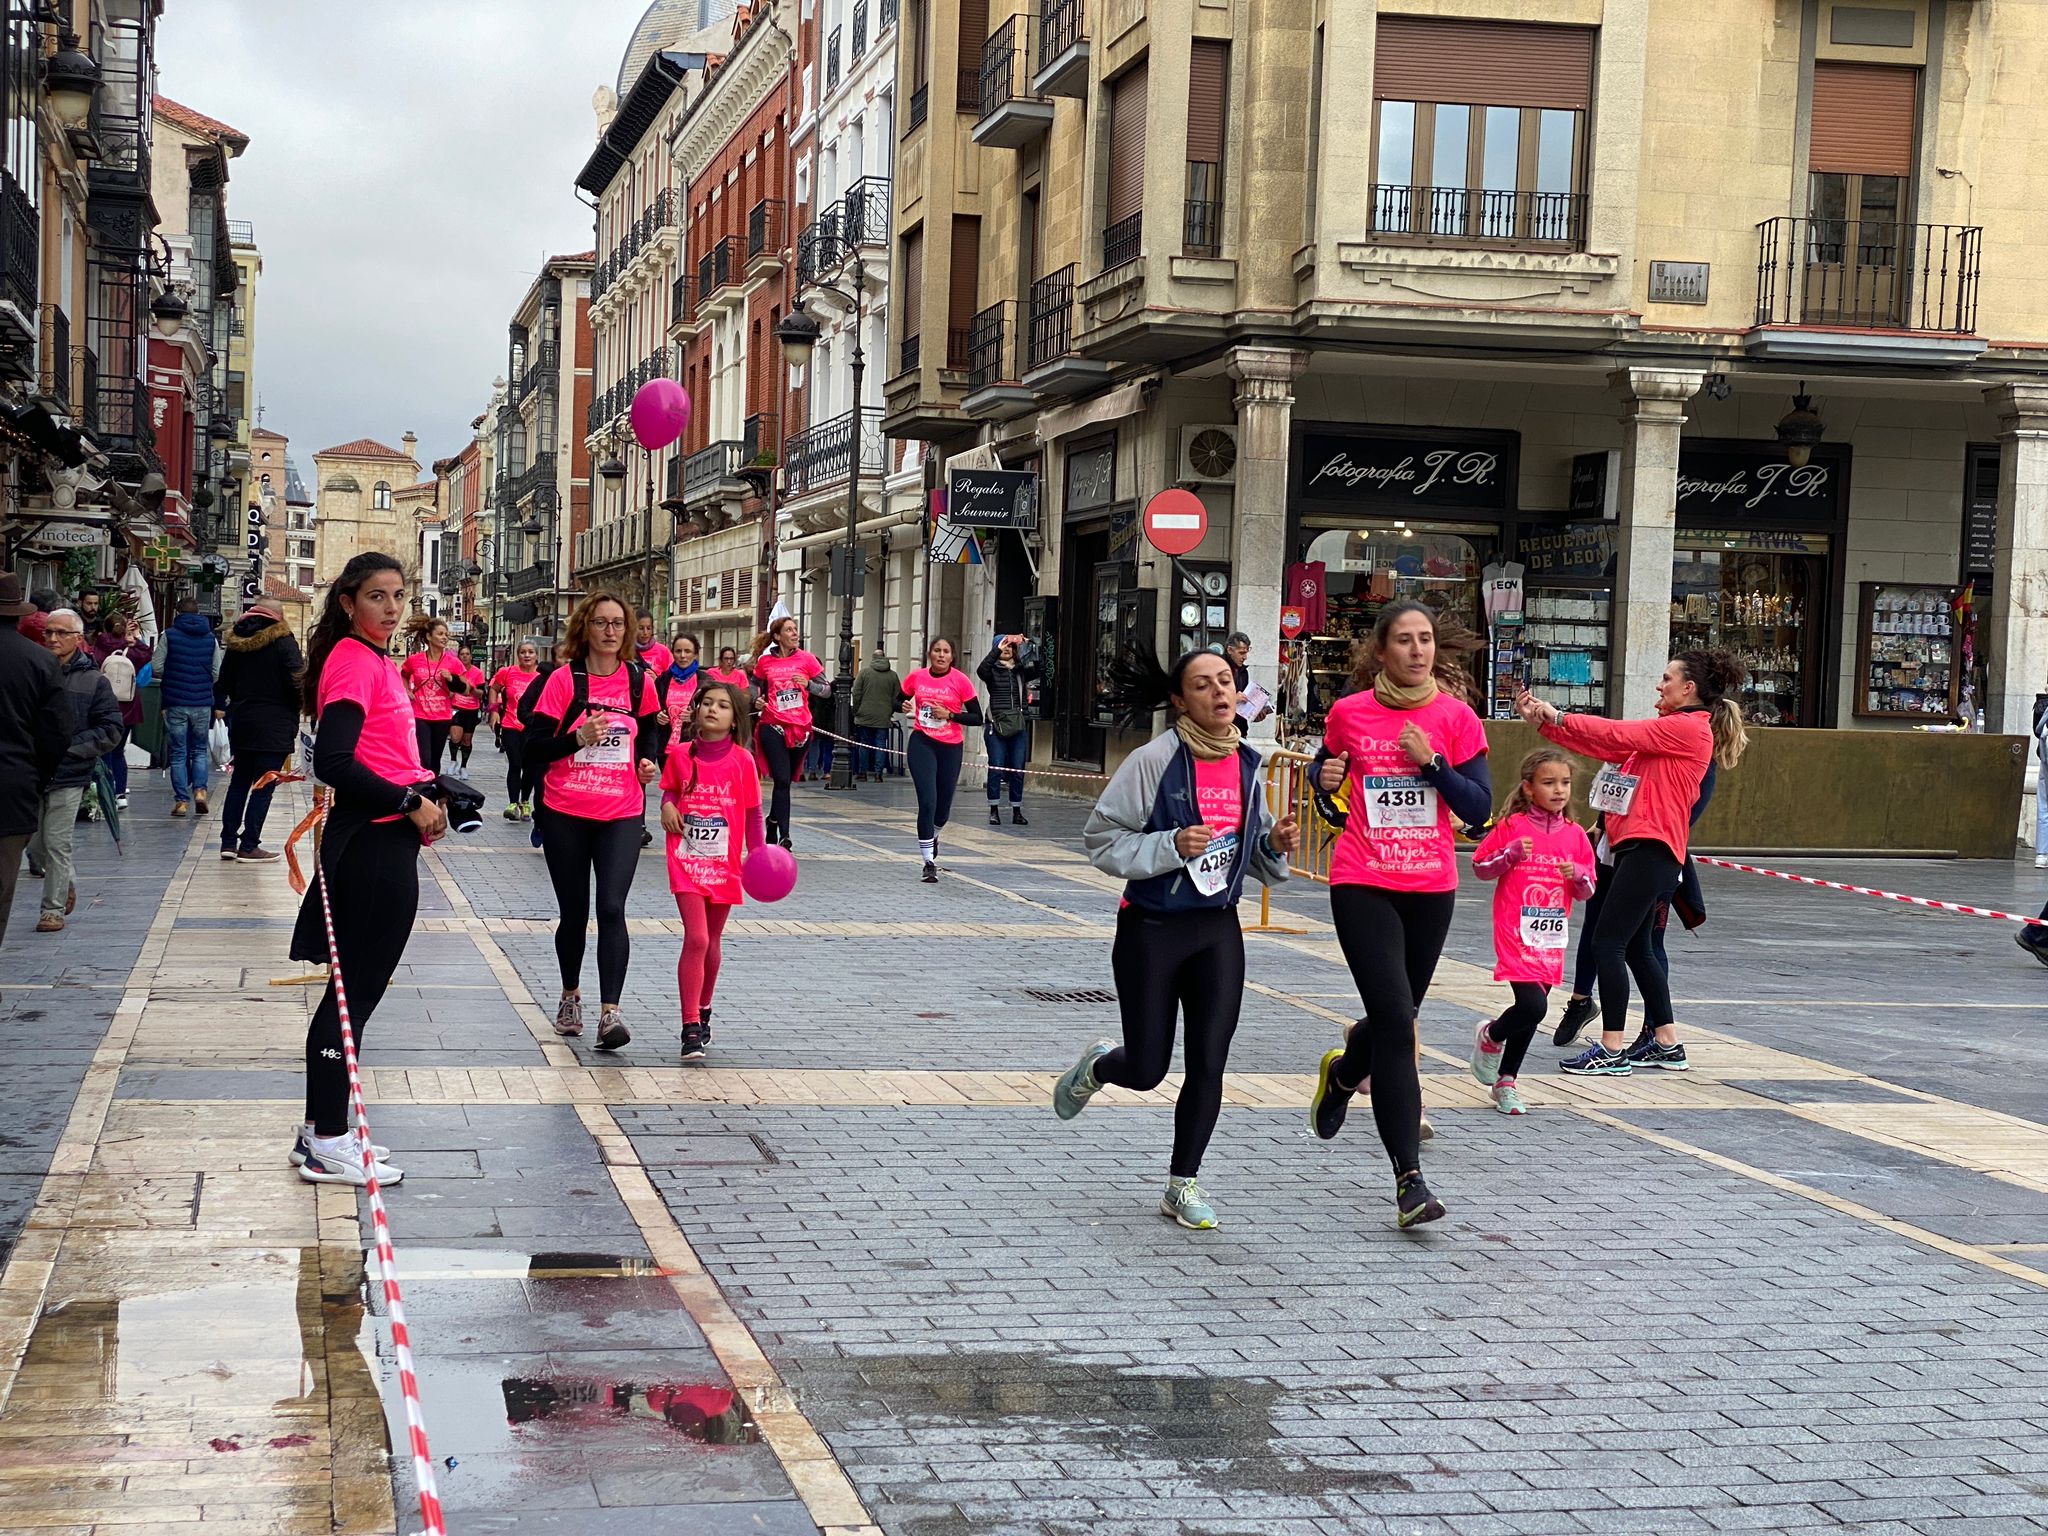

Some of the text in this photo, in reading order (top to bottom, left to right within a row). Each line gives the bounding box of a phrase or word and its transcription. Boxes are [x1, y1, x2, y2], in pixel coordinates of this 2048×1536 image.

[1663, 275, 1695, 285] PLAZA
[1655, 287, 1702, 297] DE REGLA
[954, 477, 1005, 500] Regalos
[1677, 470, 1748, 502] tografia
[954, 501, 1009, 519] Souvenir
[1519, 527, 1620, 553] RECUERDOS
[1531, 549, 1606, 569] DE LEON
[780, 693, 799, 703] 4637
[577, 769, 616, 785] Mujer
[1377, 790, 1425, 807] 4381
[1601, 783, 1629, 799] 0697
[687, 828, 720, 841] 4127
[1383, 828, 1440, 840] CARRERA
[1200, 847, 1236, 874] 4285
[1377, 842, 1430, 864] Mujer
[682, 862, 719, 879] Mujer
[1529, 919, 1564, 932] 4616
